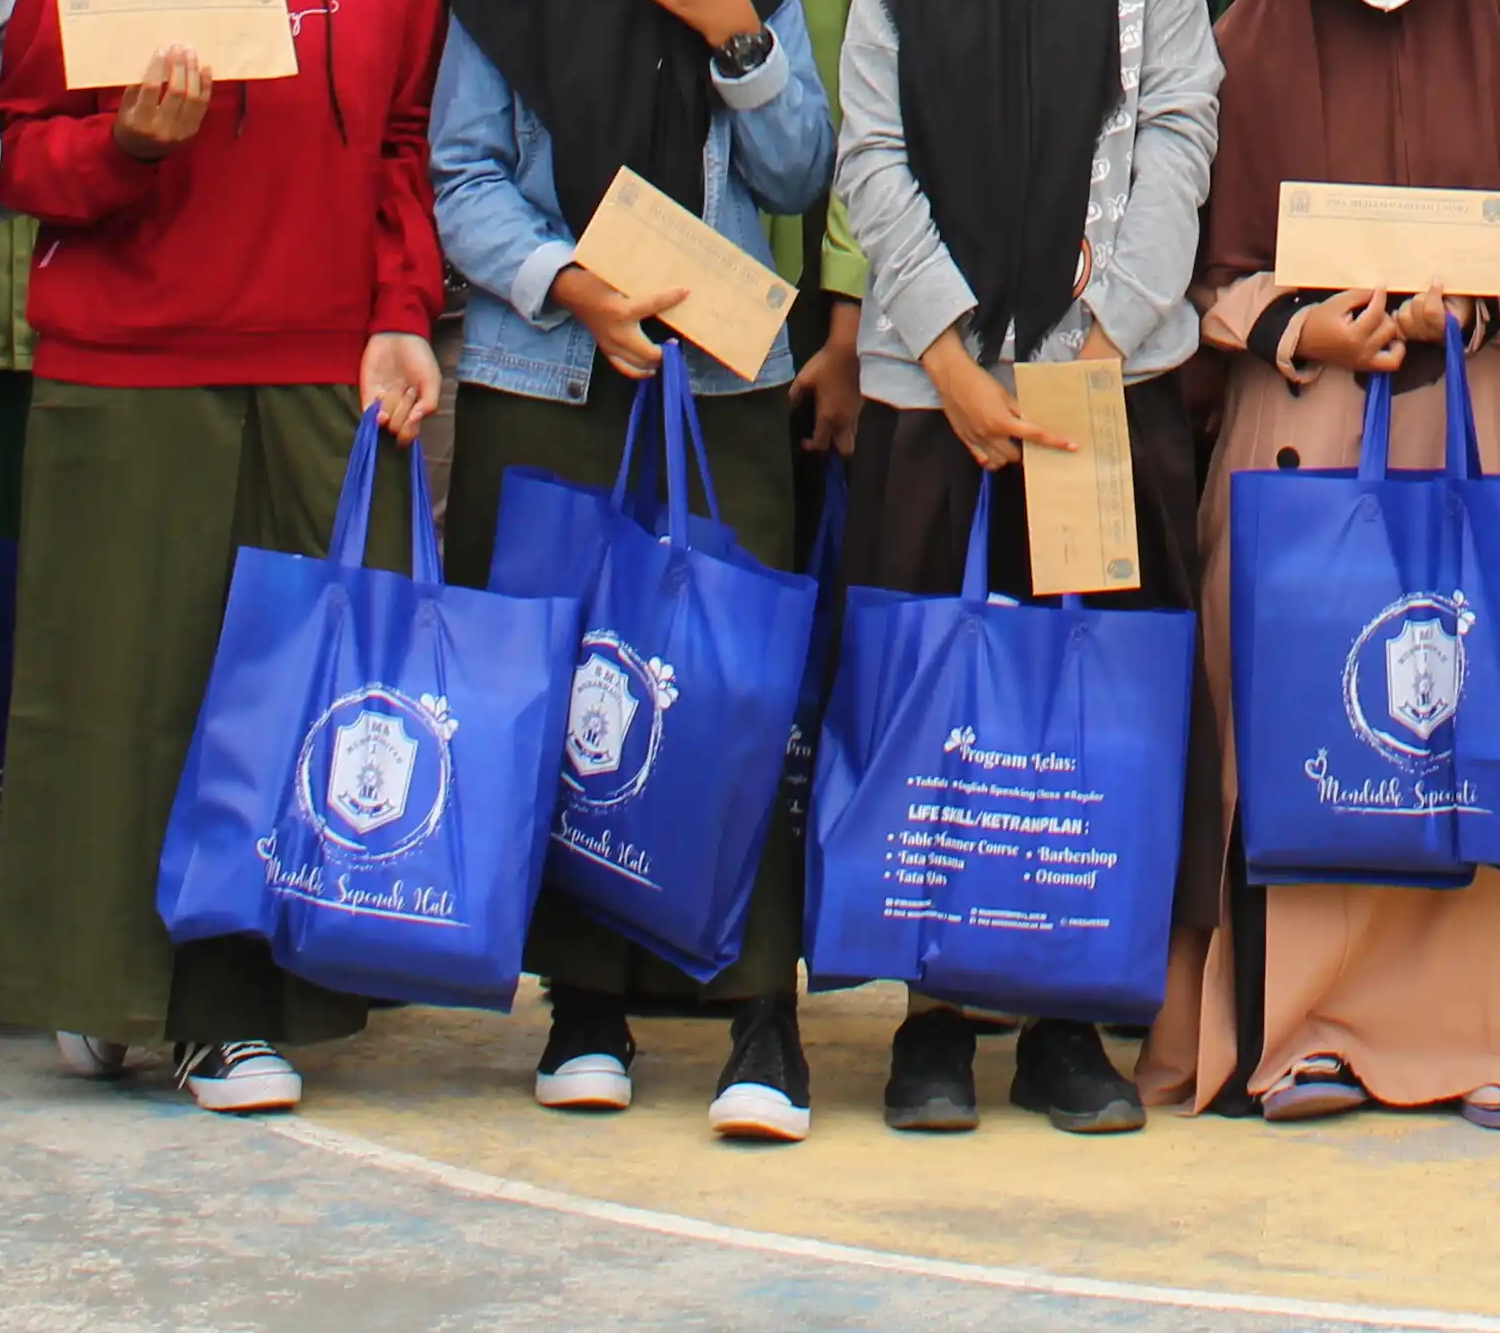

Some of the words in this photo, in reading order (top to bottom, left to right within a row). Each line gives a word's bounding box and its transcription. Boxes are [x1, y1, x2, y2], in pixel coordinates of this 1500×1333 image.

[960, 745, 1028, 770] Program
[1318, 776, 1404, 804] Mendidik
[908, 804, 939, 822] LIFE
[561, 810, 611, 858] Sepenuh
[617, 840, 652, 875] Hati
[899, 831, 933, 848] Table
[978, 840, 1020, 857] Course
[897, 850, 926, 867] Tata
[1037, 846, 1118, 868] Barbershop
[896, 869, 924, 885] Tata
[1035, 868, 1099, 890] Otomotif
[336, 873, 406, 916] Sepenuh
[414, 886, 456, 916] Hati
